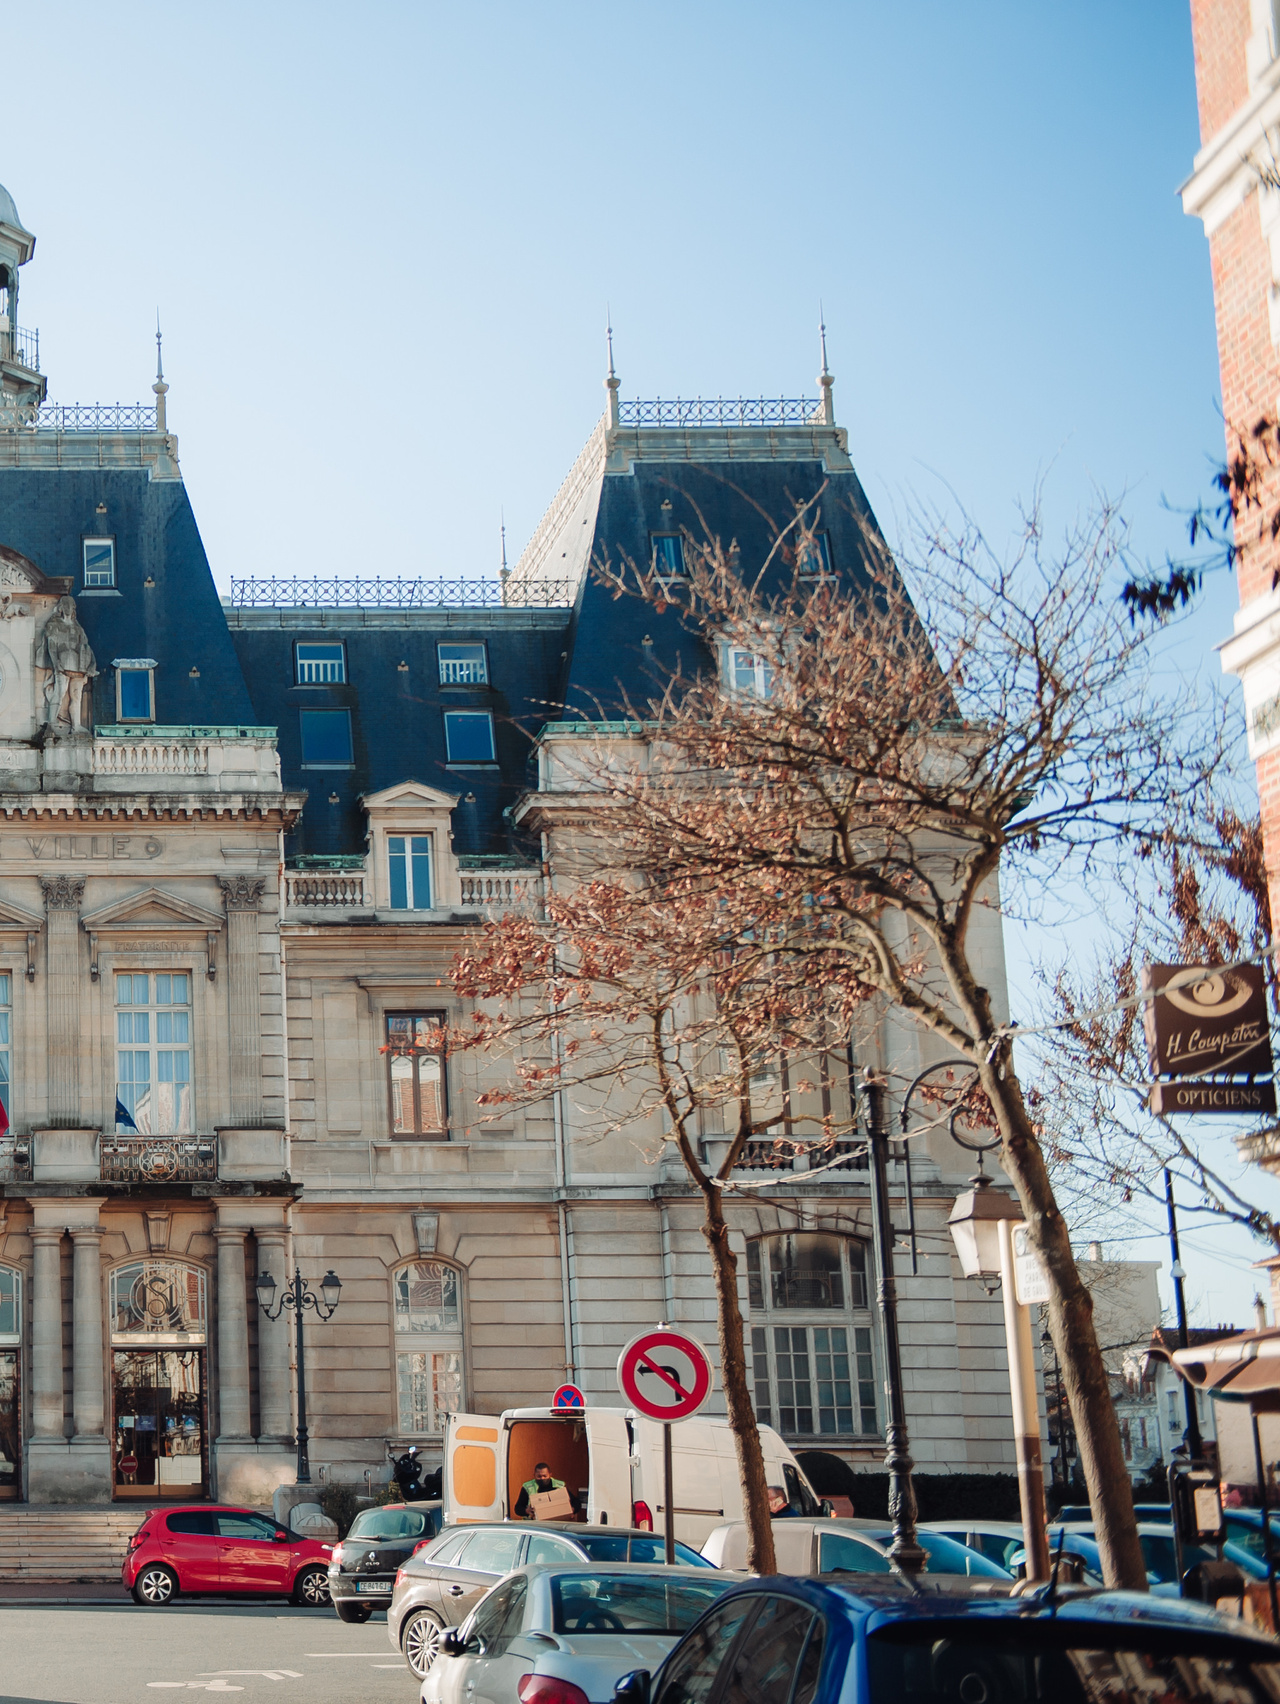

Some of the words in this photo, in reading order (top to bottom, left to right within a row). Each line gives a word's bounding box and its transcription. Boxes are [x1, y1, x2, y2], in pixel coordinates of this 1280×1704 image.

[25, 836, 131, 860] VILLE
[1166, 1032, 1182, 1058] H.
[1176, 1089, 1262, 1106] OPTICIENS
